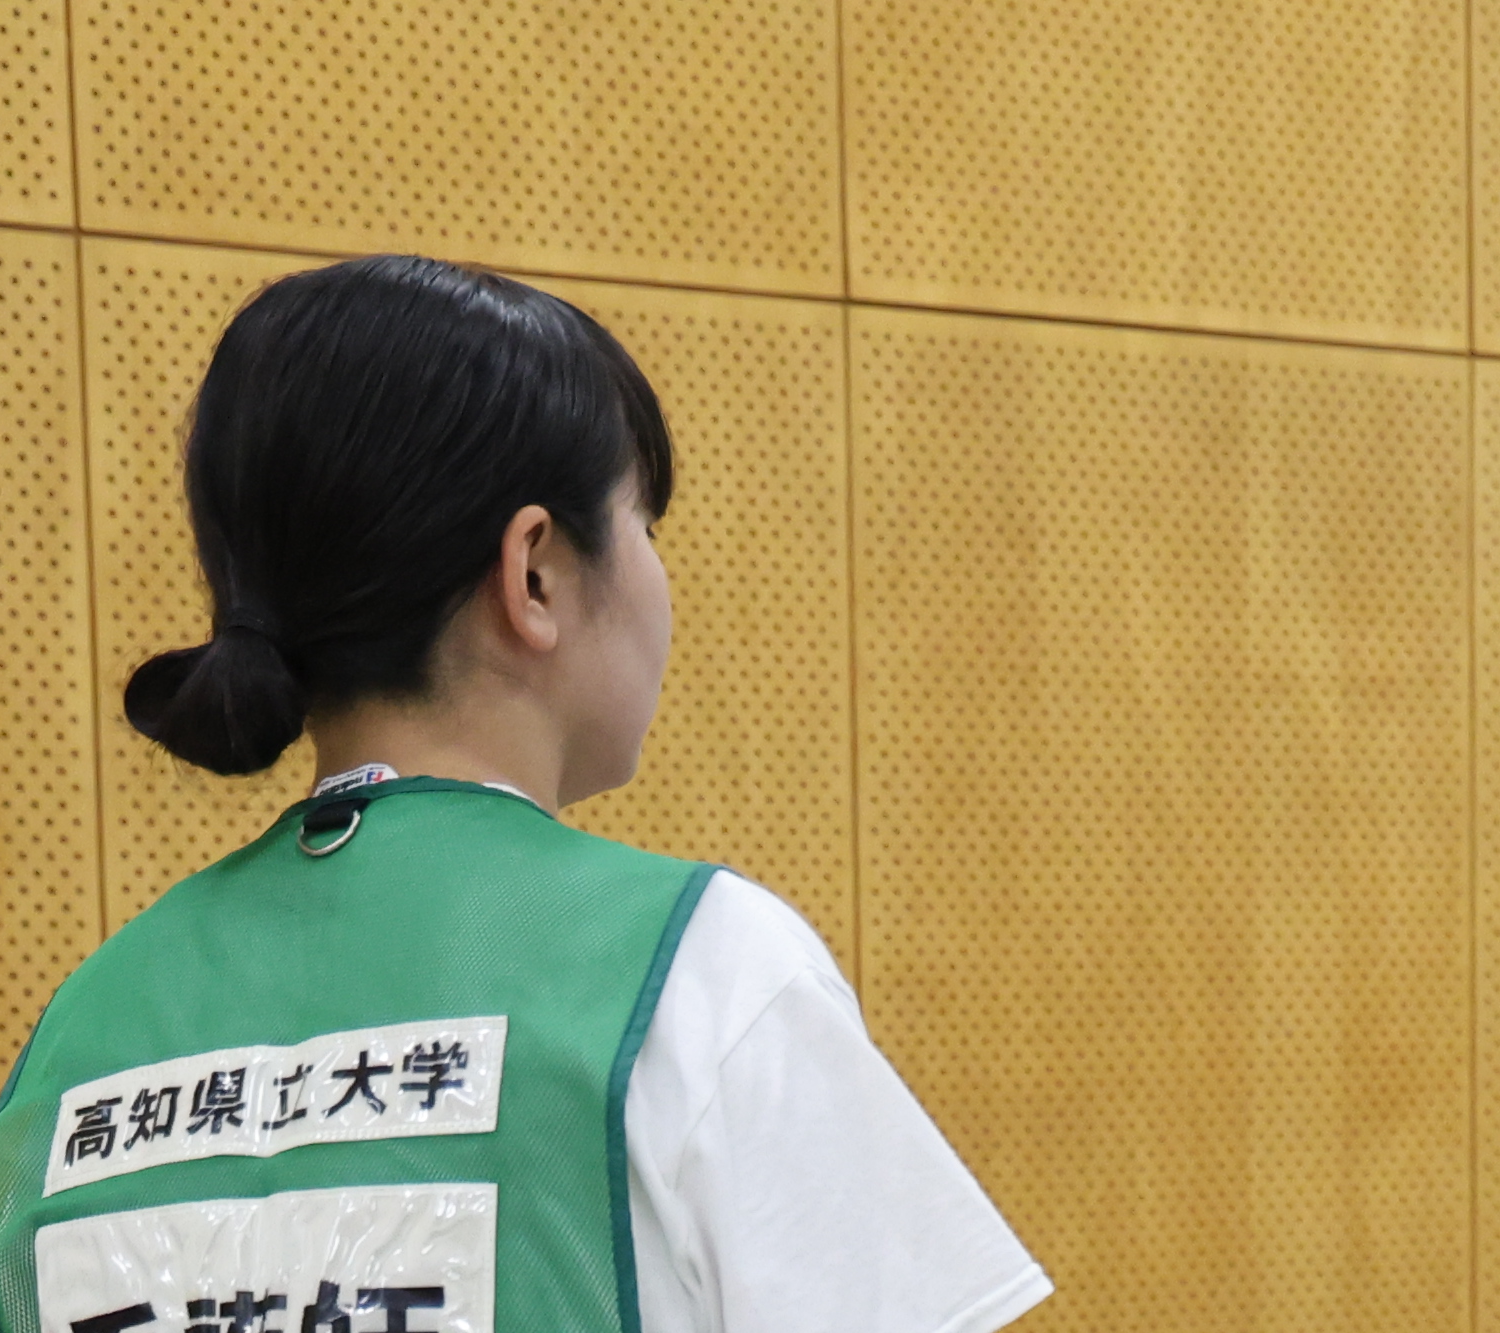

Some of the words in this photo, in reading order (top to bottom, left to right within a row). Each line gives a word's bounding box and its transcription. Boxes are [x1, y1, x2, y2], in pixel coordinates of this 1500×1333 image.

[63, 1040, 468, 1168] 高知県立大学
